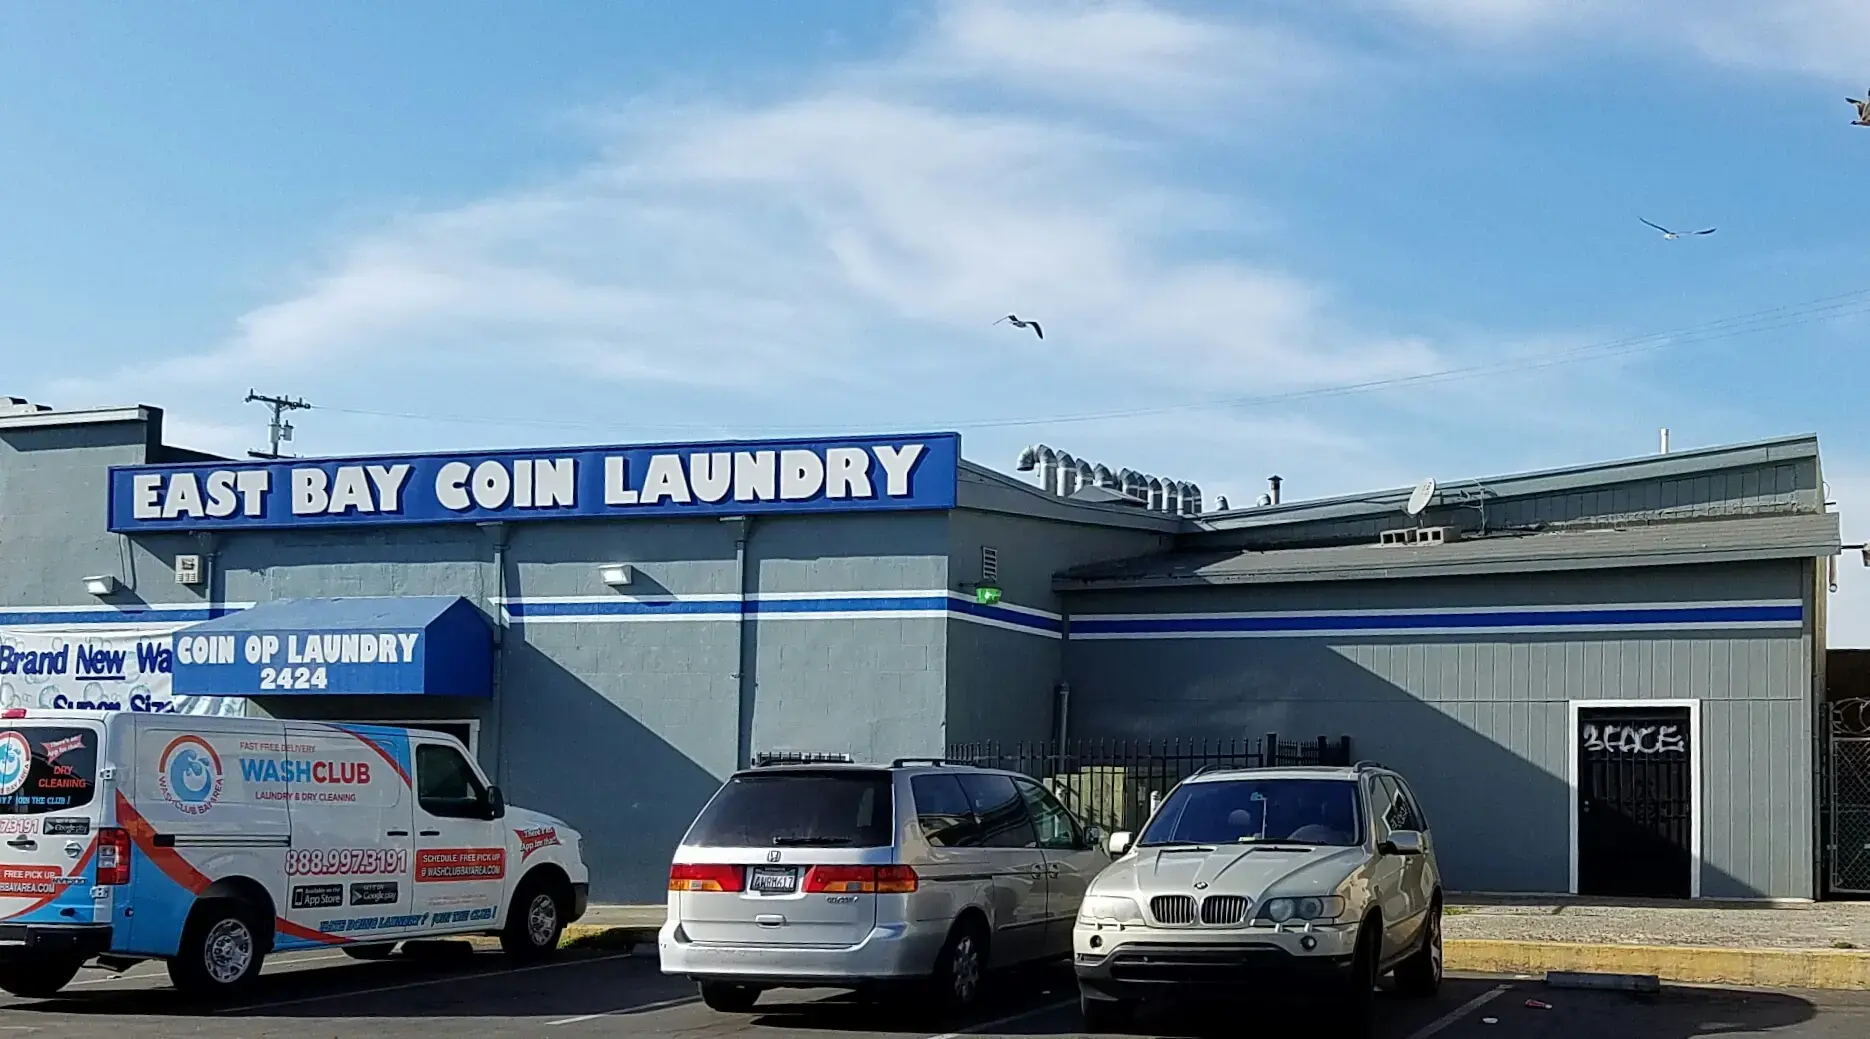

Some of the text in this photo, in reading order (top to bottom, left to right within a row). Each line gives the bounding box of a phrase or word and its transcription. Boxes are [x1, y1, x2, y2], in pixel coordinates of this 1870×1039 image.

[133, 444, 925, 519] EAST BAY COIN LAUNDRY
[177, 633, 419, 665] COIN OP LAUNDRY
[0, 644, 70, 675] Brand
[75, 643, 126, 675] New
[260, 667, 328, 690] 2424
[239, 741, 316, 753] FAST FREE DELIVERY
[53, 765, 73, 775] DRY
[239, 758, 371, 784] WASHCLUB
[38, 778, 87, 788] CLEANING
[255, 791, 293, 800] LAUNDRY
[301, 792, 318, 801] DRY
[318, 793, 356, 802] CLEANING
[423, 853, 501, 863] SCHEDULE FREE PICK UP
[3, 869, 24, 879] FREE
[24, 870, 43, 879] PICK
[303, 893, 341, 906] App Store
